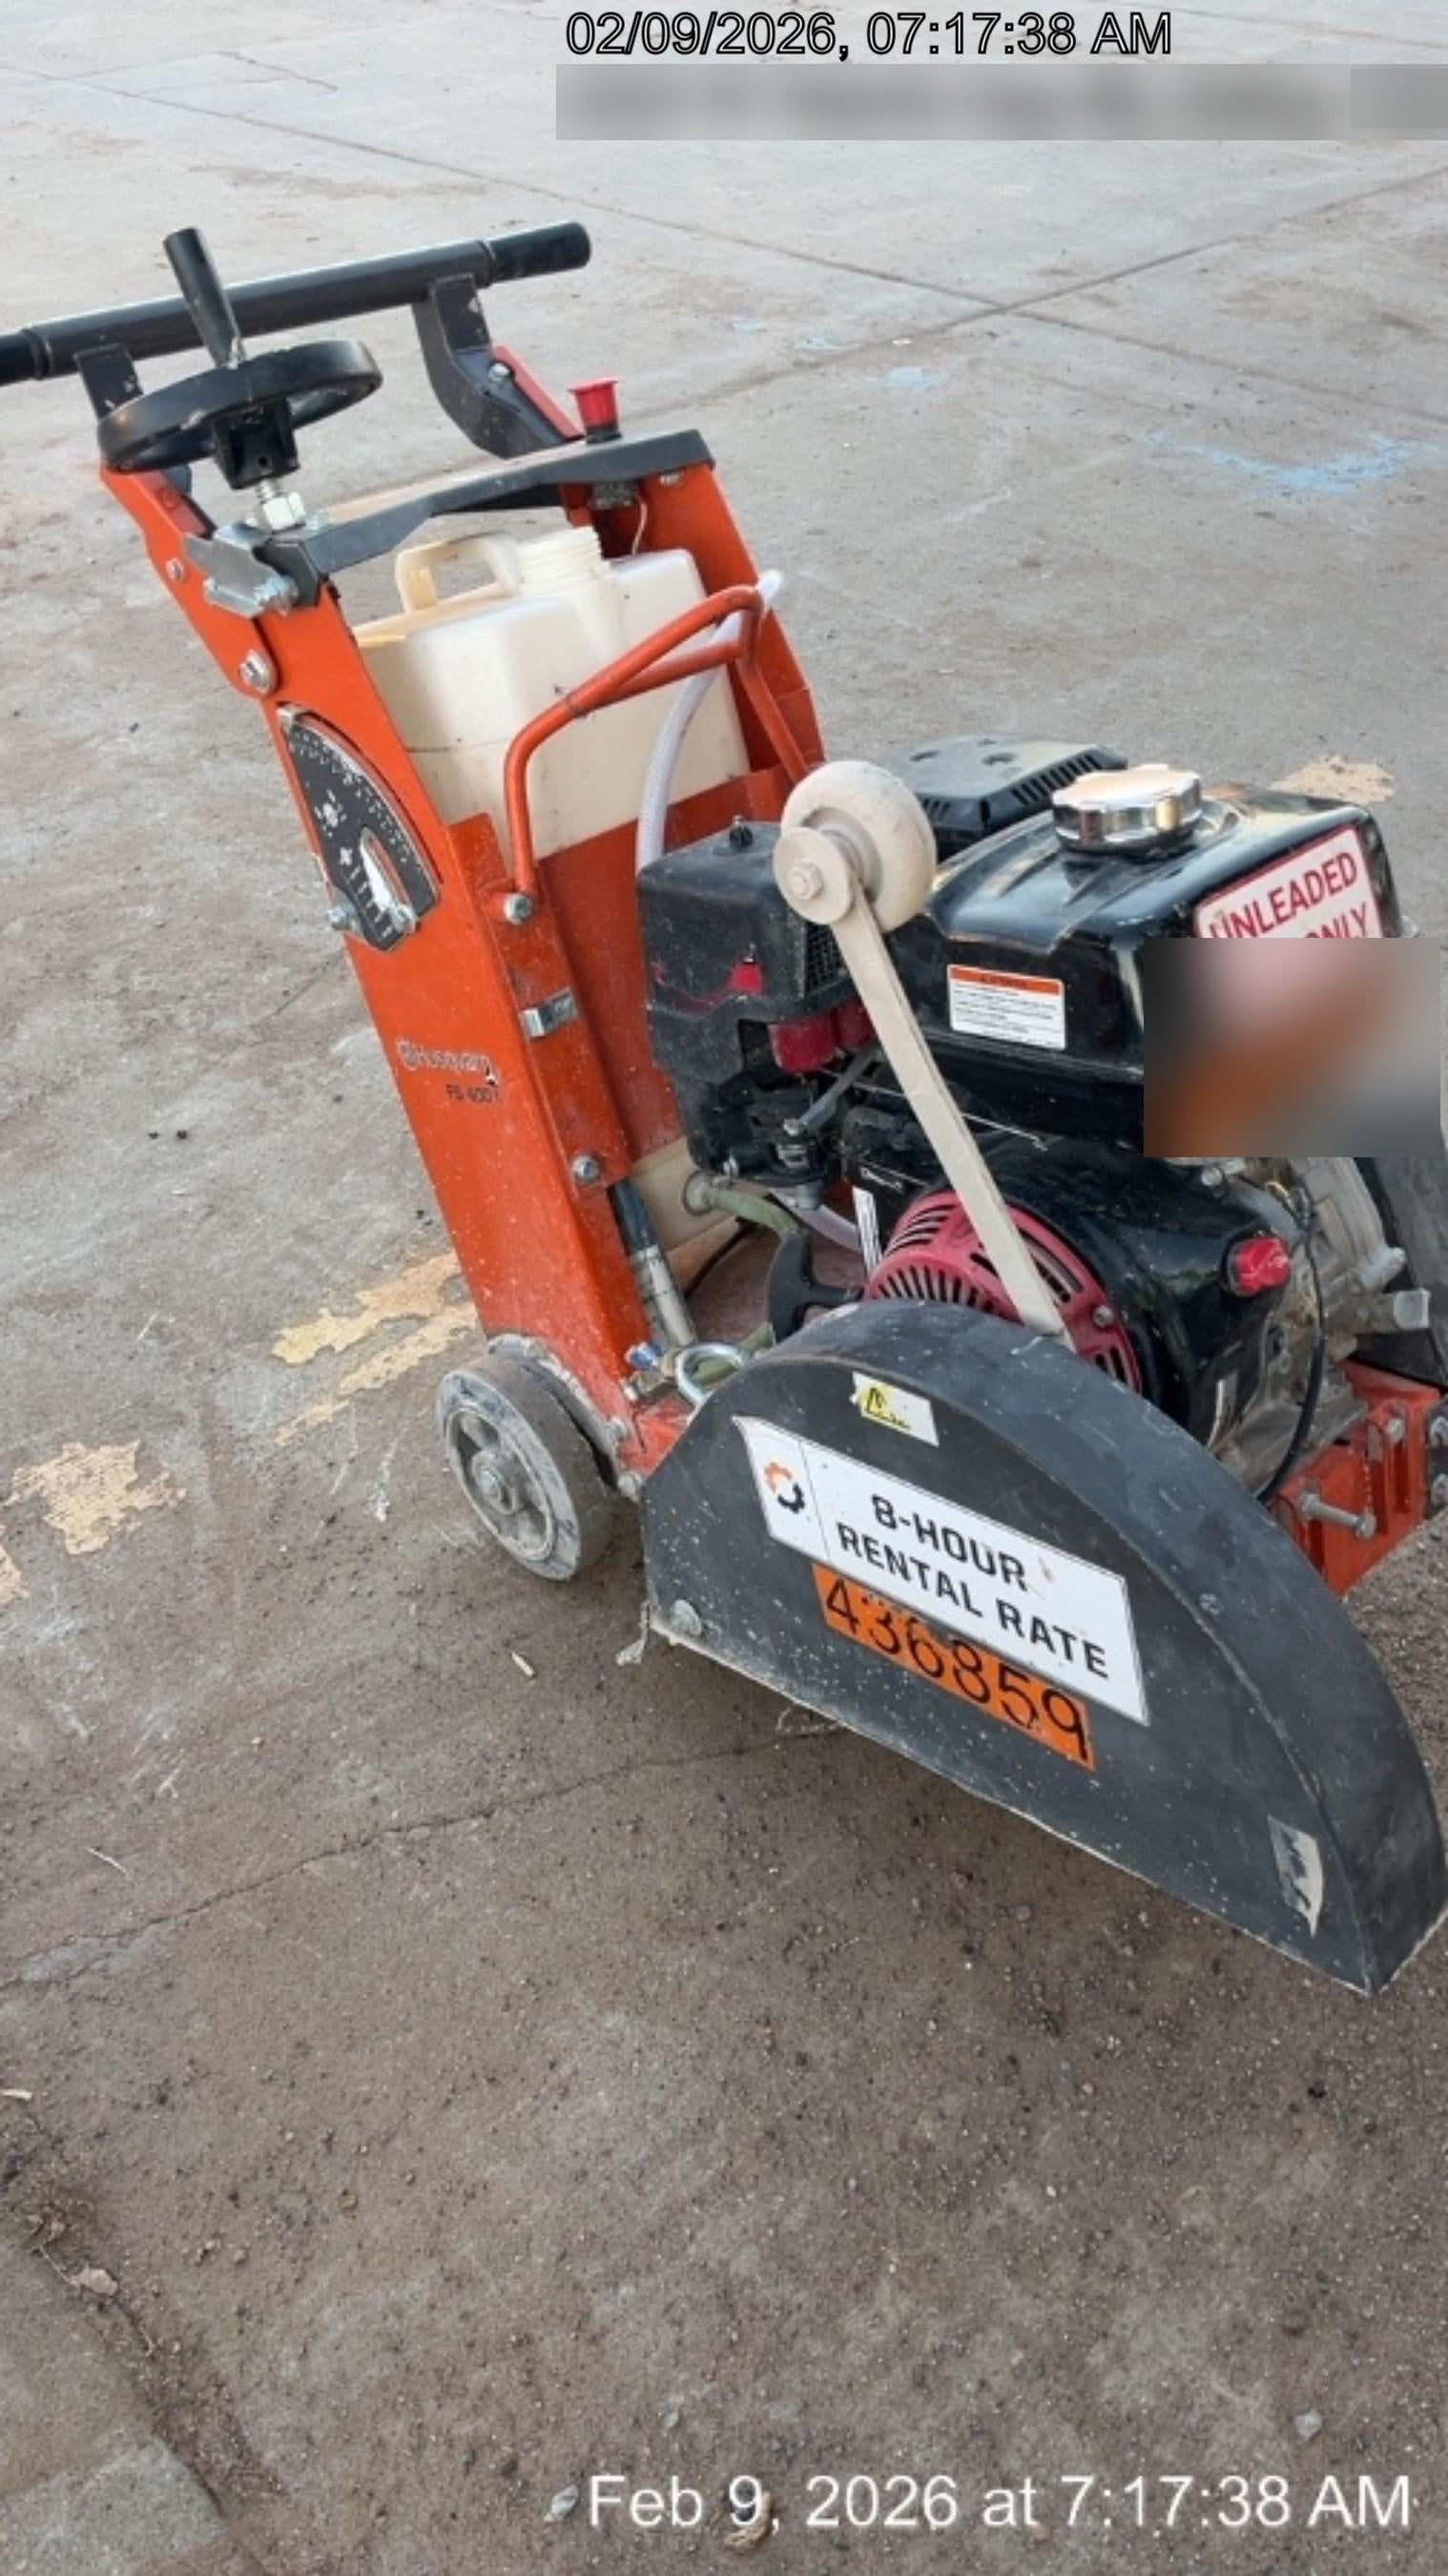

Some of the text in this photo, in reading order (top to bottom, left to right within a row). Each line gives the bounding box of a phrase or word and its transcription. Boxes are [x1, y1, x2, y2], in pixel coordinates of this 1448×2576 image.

[1209, 852, 1358, 938] UNLEADED
[836, 1522, 1108, 1679] RENTAL RATE
[872, 1493, 1028, 1592] 8-HOUR
[826, 1577, 1088, 1762] 436859
